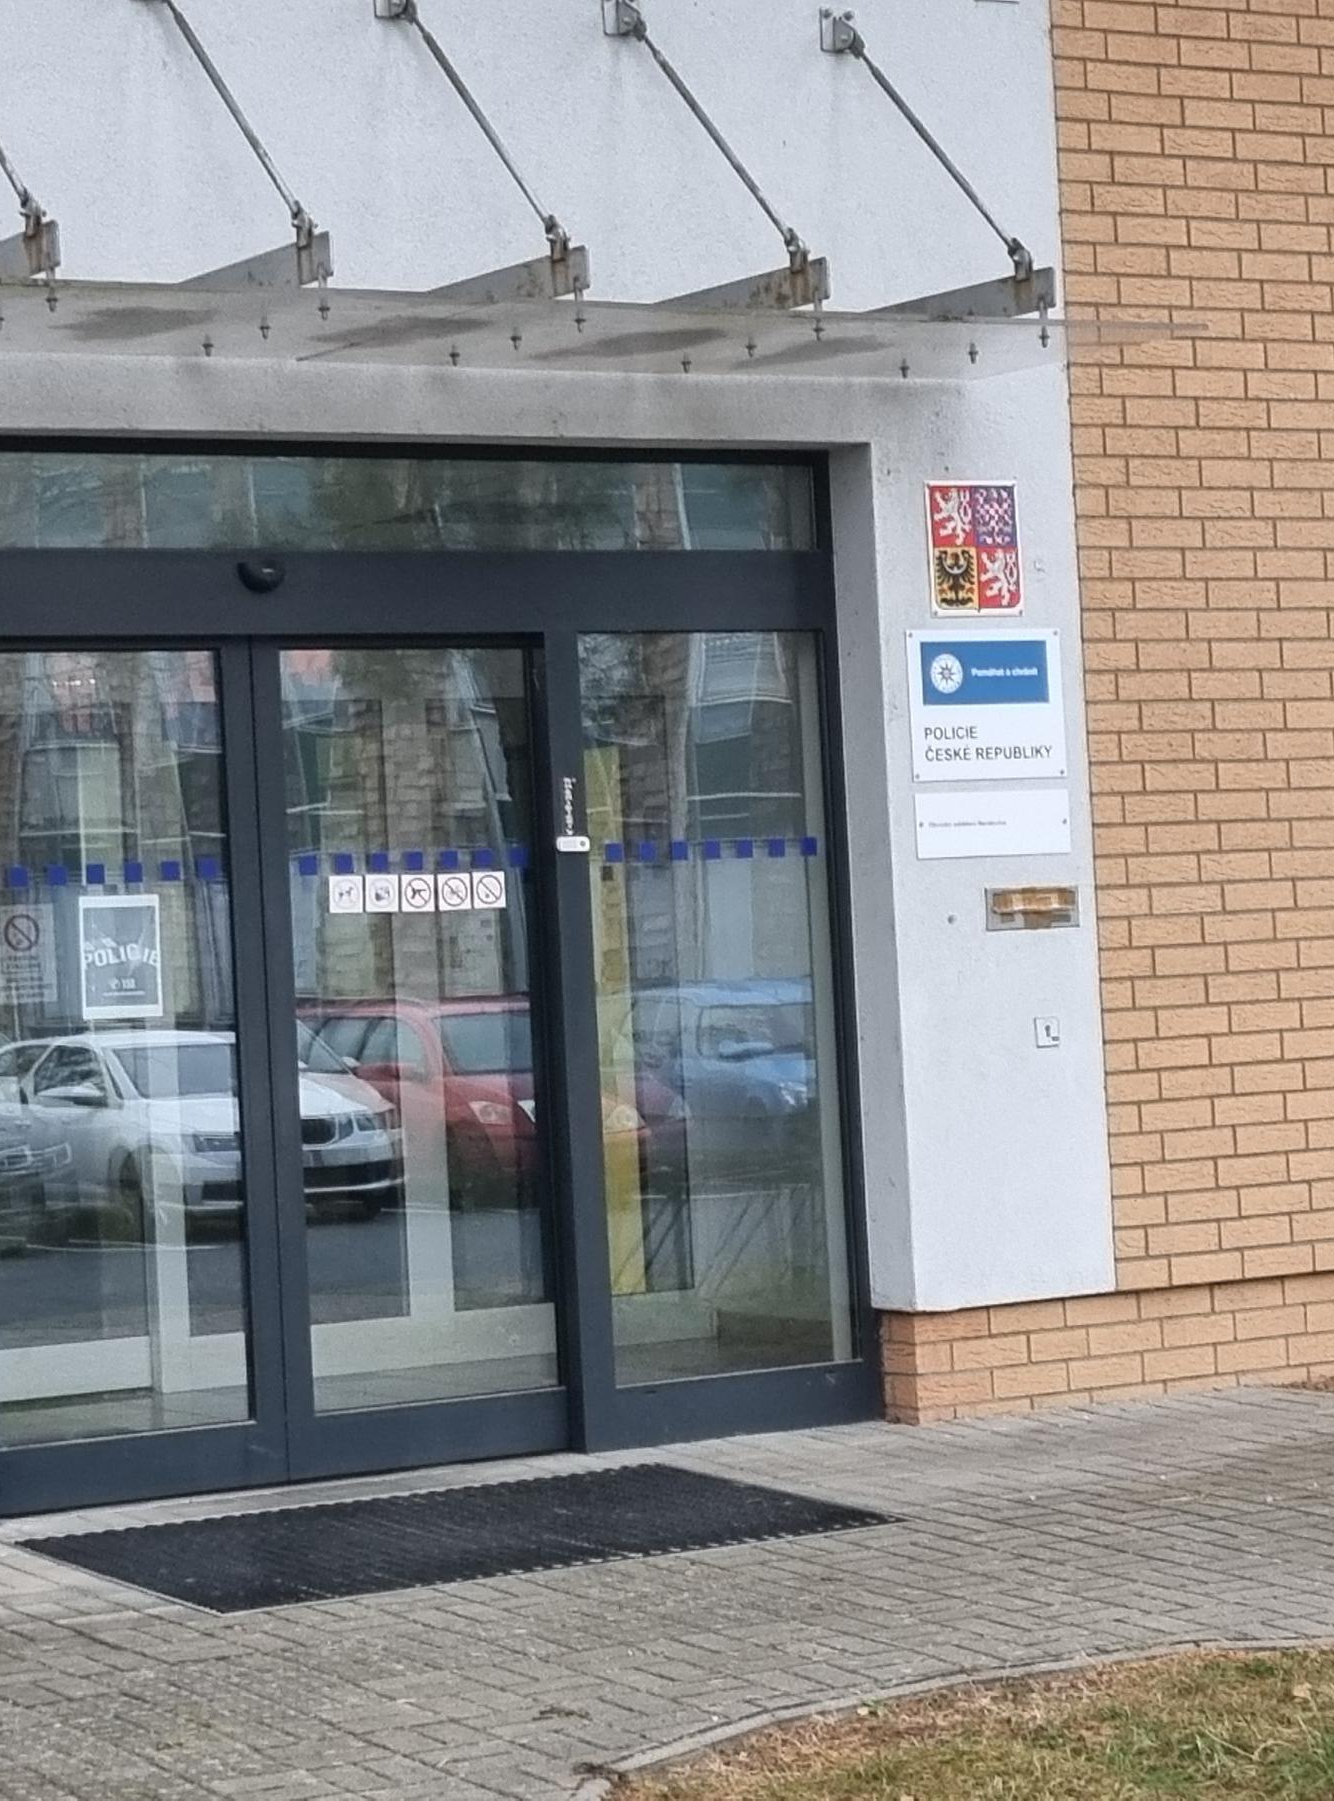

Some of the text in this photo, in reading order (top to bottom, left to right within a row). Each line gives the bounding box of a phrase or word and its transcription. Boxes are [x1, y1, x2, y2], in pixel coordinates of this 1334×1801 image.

[924, 727, 978, 740] POLICIE
[925, 745, 1052, 761] ČESKÉ REPUBLIKY
[83, 943, 158, 968] POLICIE
